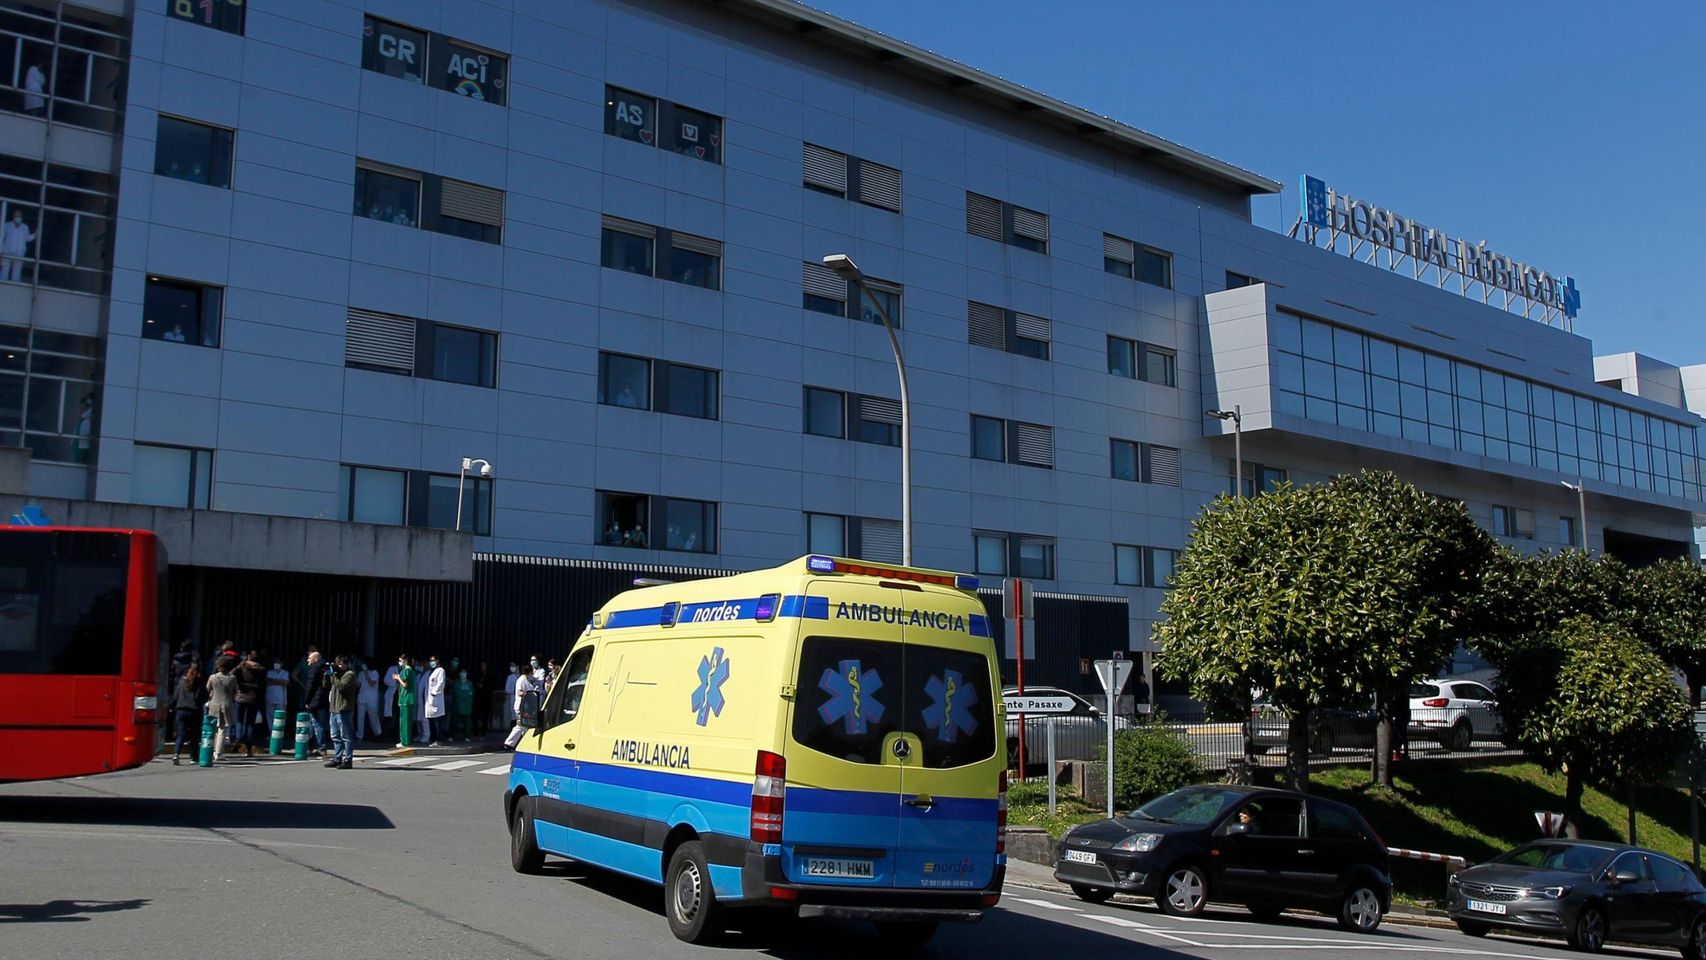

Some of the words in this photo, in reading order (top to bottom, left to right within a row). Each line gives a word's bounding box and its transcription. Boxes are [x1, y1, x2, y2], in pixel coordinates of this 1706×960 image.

[379, 34, 416, 65] GR
[616, 101, 643, 126] AS
[1329, 188, 1459, 273] HOSPITAL
[1460, 239, 1558, 307] PÚBLICO
[692, 601, 741, 622] nordes
[836, 601, 966, 633] AMBULANCIA
[1007, 701, 1023, 709] nte
[1028, 701, 1063, 709] Pasaxe
[611, 739, 691, 769] AMBULANCIA
[811, 860, 842, 874] 2281
[847, 862, 872, 876] HMM
[1472, 902, 1488, 910] 1321
